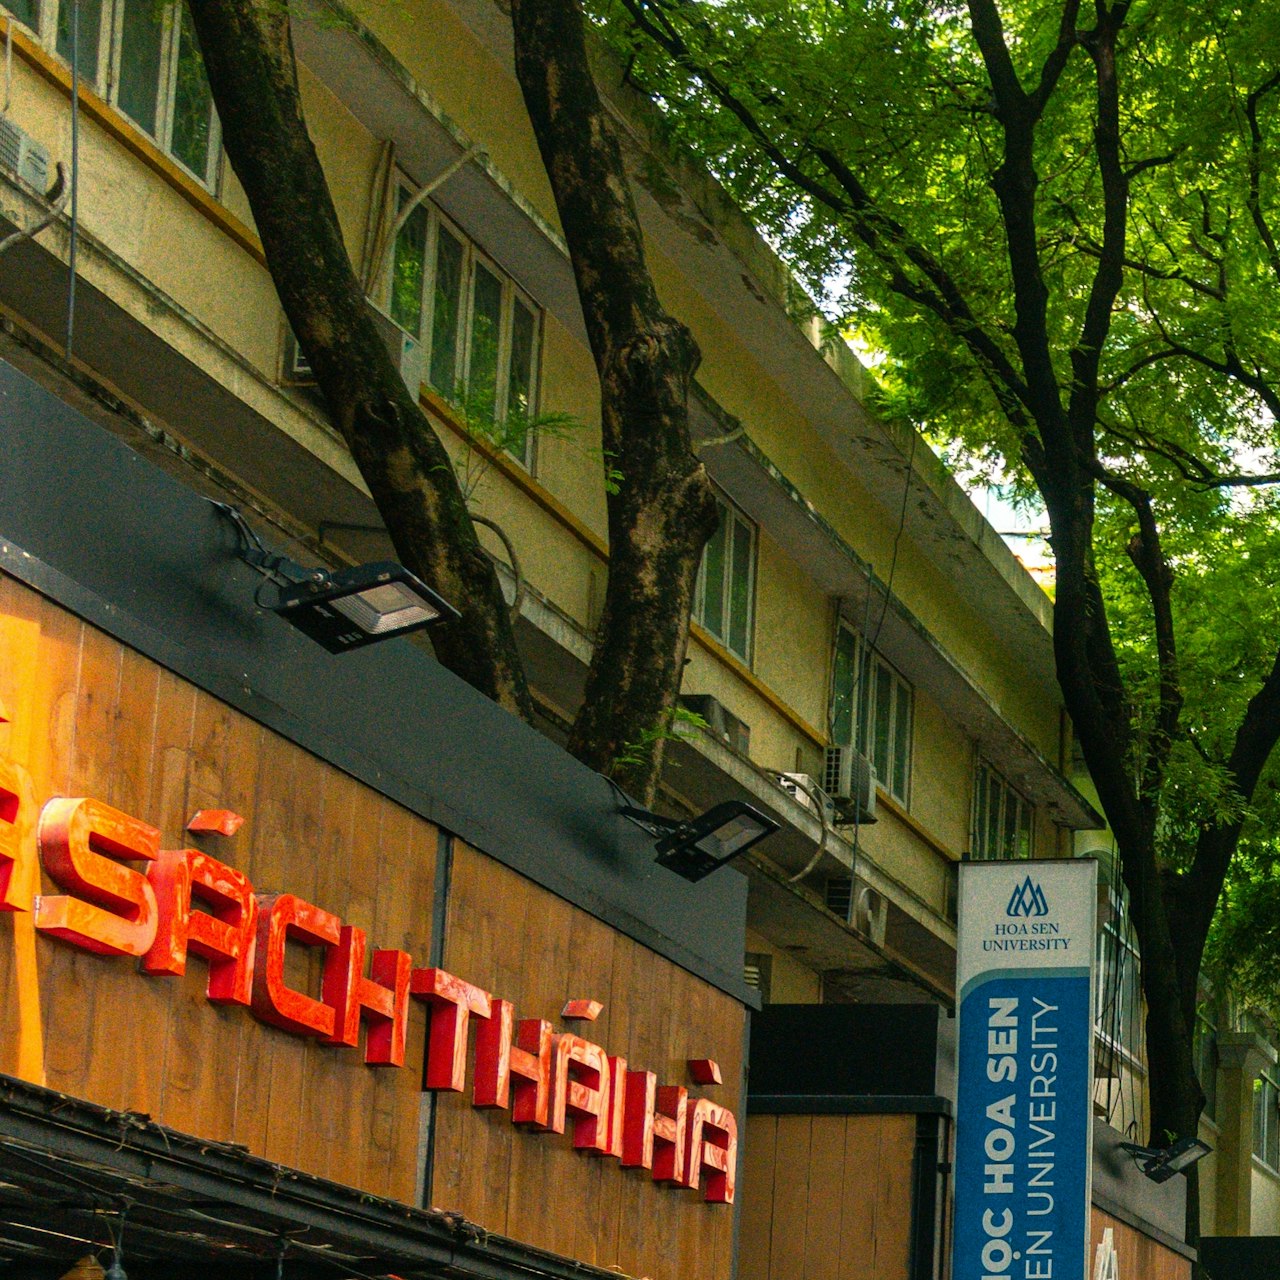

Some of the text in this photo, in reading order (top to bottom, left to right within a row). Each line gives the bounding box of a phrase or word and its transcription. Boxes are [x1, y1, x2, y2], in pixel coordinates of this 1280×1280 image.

[36, 796, 412, 1068] SÁCH
[983, 939, 1070, 951] UNIVERSITY
[995, 923, 1059, 935] HOA SEN
[987, 997, 1019, 1082] SEN
[984, 1094, 1016, 1193] HOA
[1027, 997, 1058, 1216] UNIVERSITY
